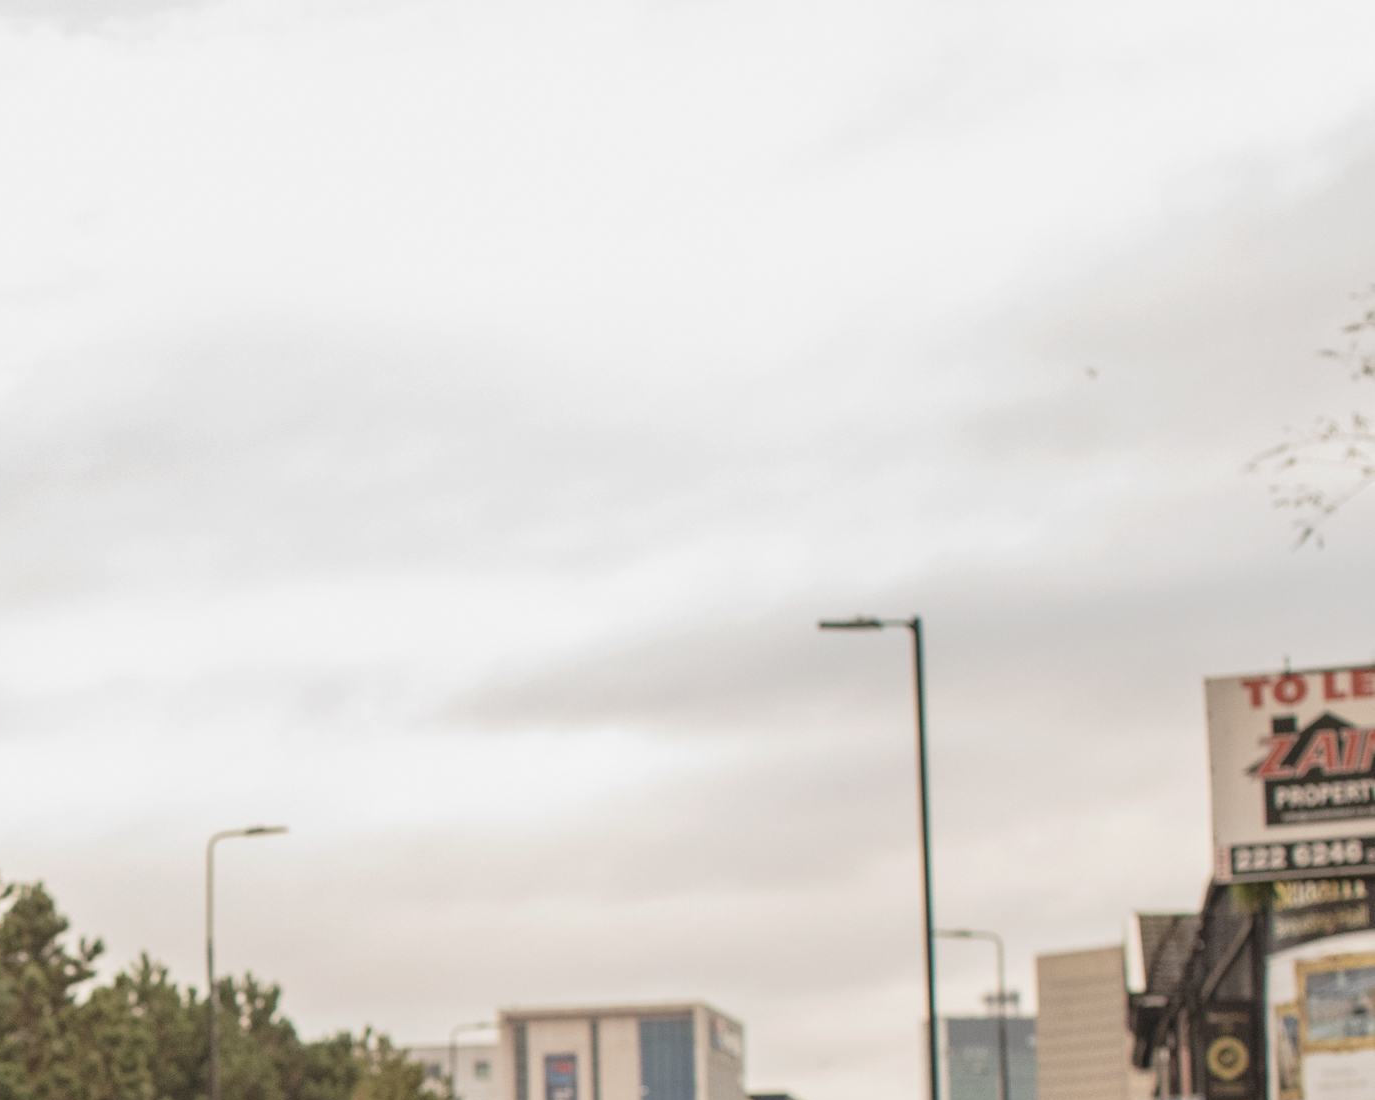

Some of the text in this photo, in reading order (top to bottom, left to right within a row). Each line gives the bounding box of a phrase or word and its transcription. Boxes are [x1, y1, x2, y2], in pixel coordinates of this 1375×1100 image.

[1241, 668, 1375, 709] TO LE
[1275, 780, 1375, 809] PROPERT
[1234, 846, 1288, 872] 222
